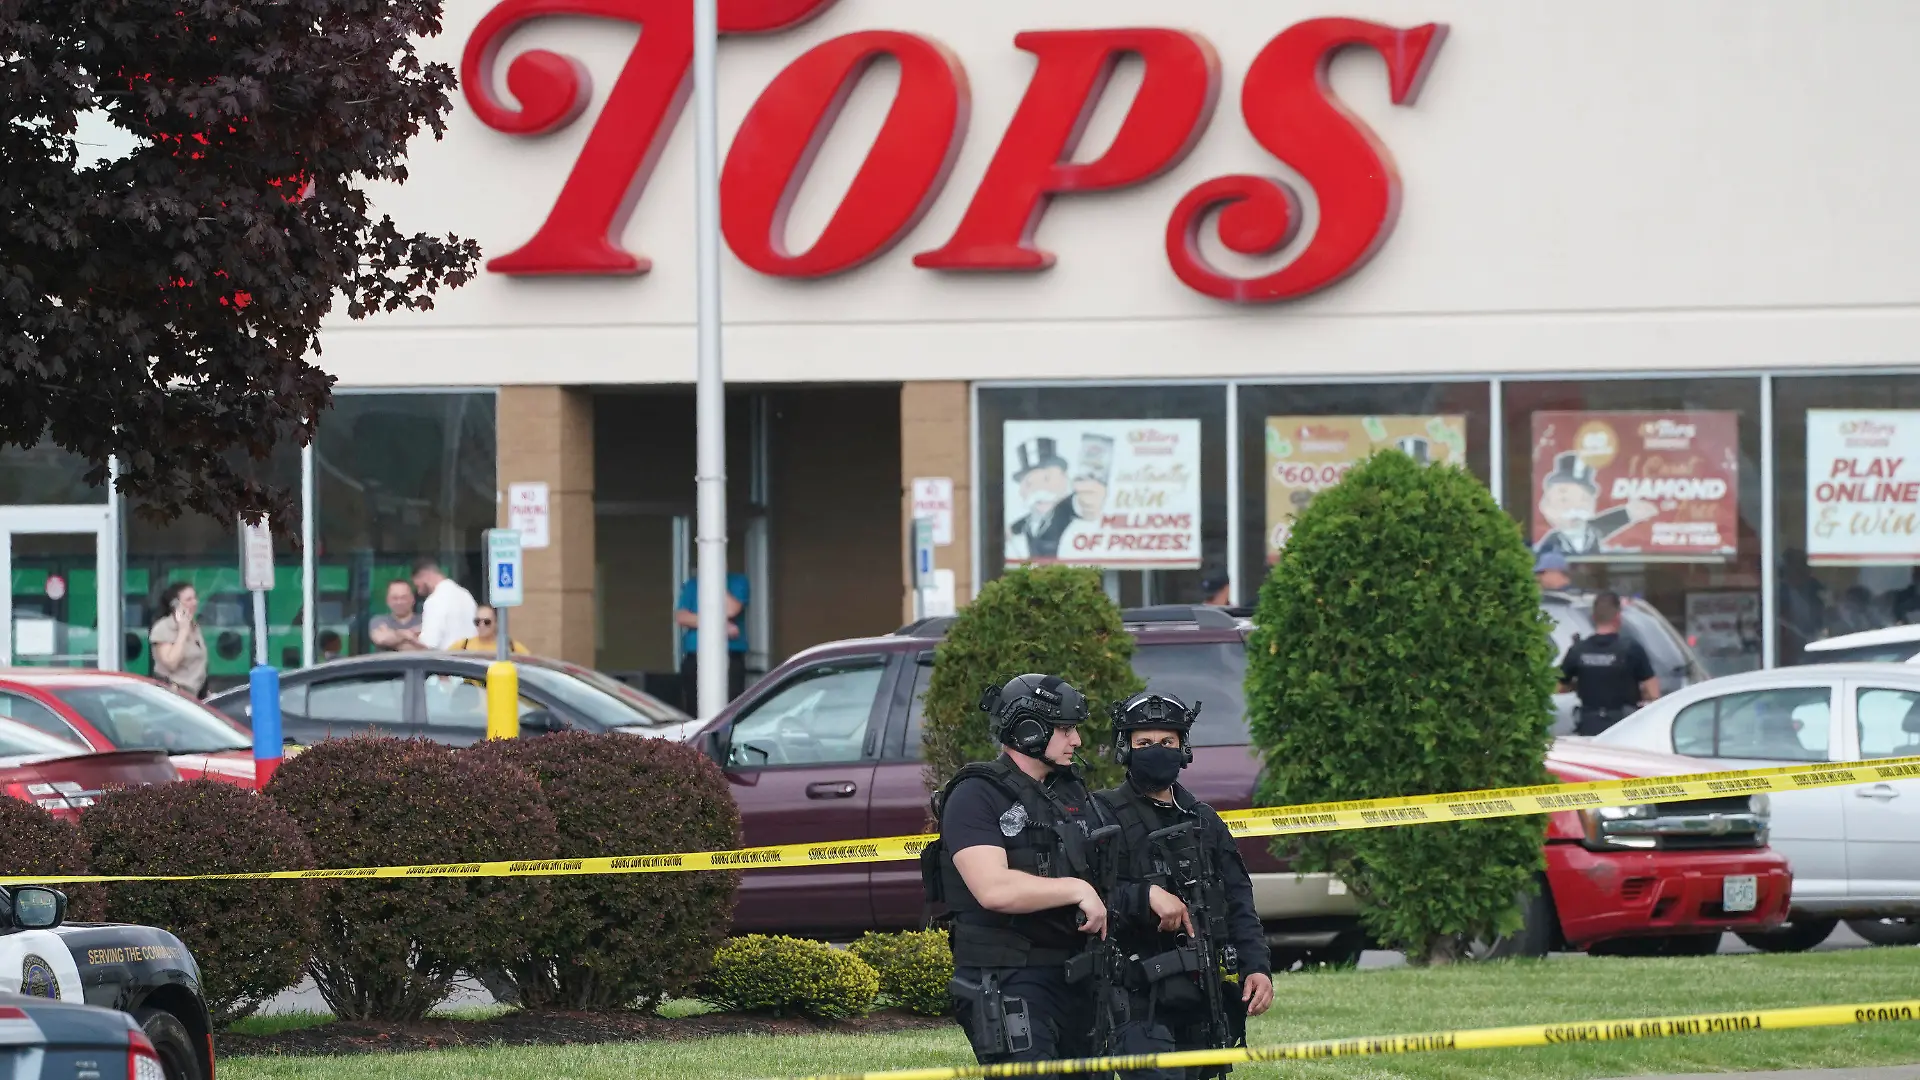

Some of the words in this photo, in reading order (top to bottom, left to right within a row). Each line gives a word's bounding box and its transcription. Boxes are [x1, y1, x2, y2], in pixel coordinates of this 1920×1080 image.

[461, 0, 1449, 304] TOPS
[1830, 457, 1904, 478] PLAY
[1611, 477, 1727, 499] DIAMOND
[1815, 482, 1920, 503] ONLINE
[1100, 513, 1192, 530] MILLIONS
[1814, 506, 1841, 538] &
[1073, 534, 1104, 551] OF
[1108, 534, 1192, 551] PRIZES!
[88, 948, 124, 965] SERVING
[124, 947, 143, 962] THE
[1855, 1005, 1912, 1022] CROSS
[1605, 1024, 1634, 1040] NOT
[1640, 1022, 1662, 1037] DO
[1668, 1019, 1700, 1035] LINE
[1705, 1014, 1762, 1032] POLICE
[1544, 1027, 1598, 1045] CROSS
